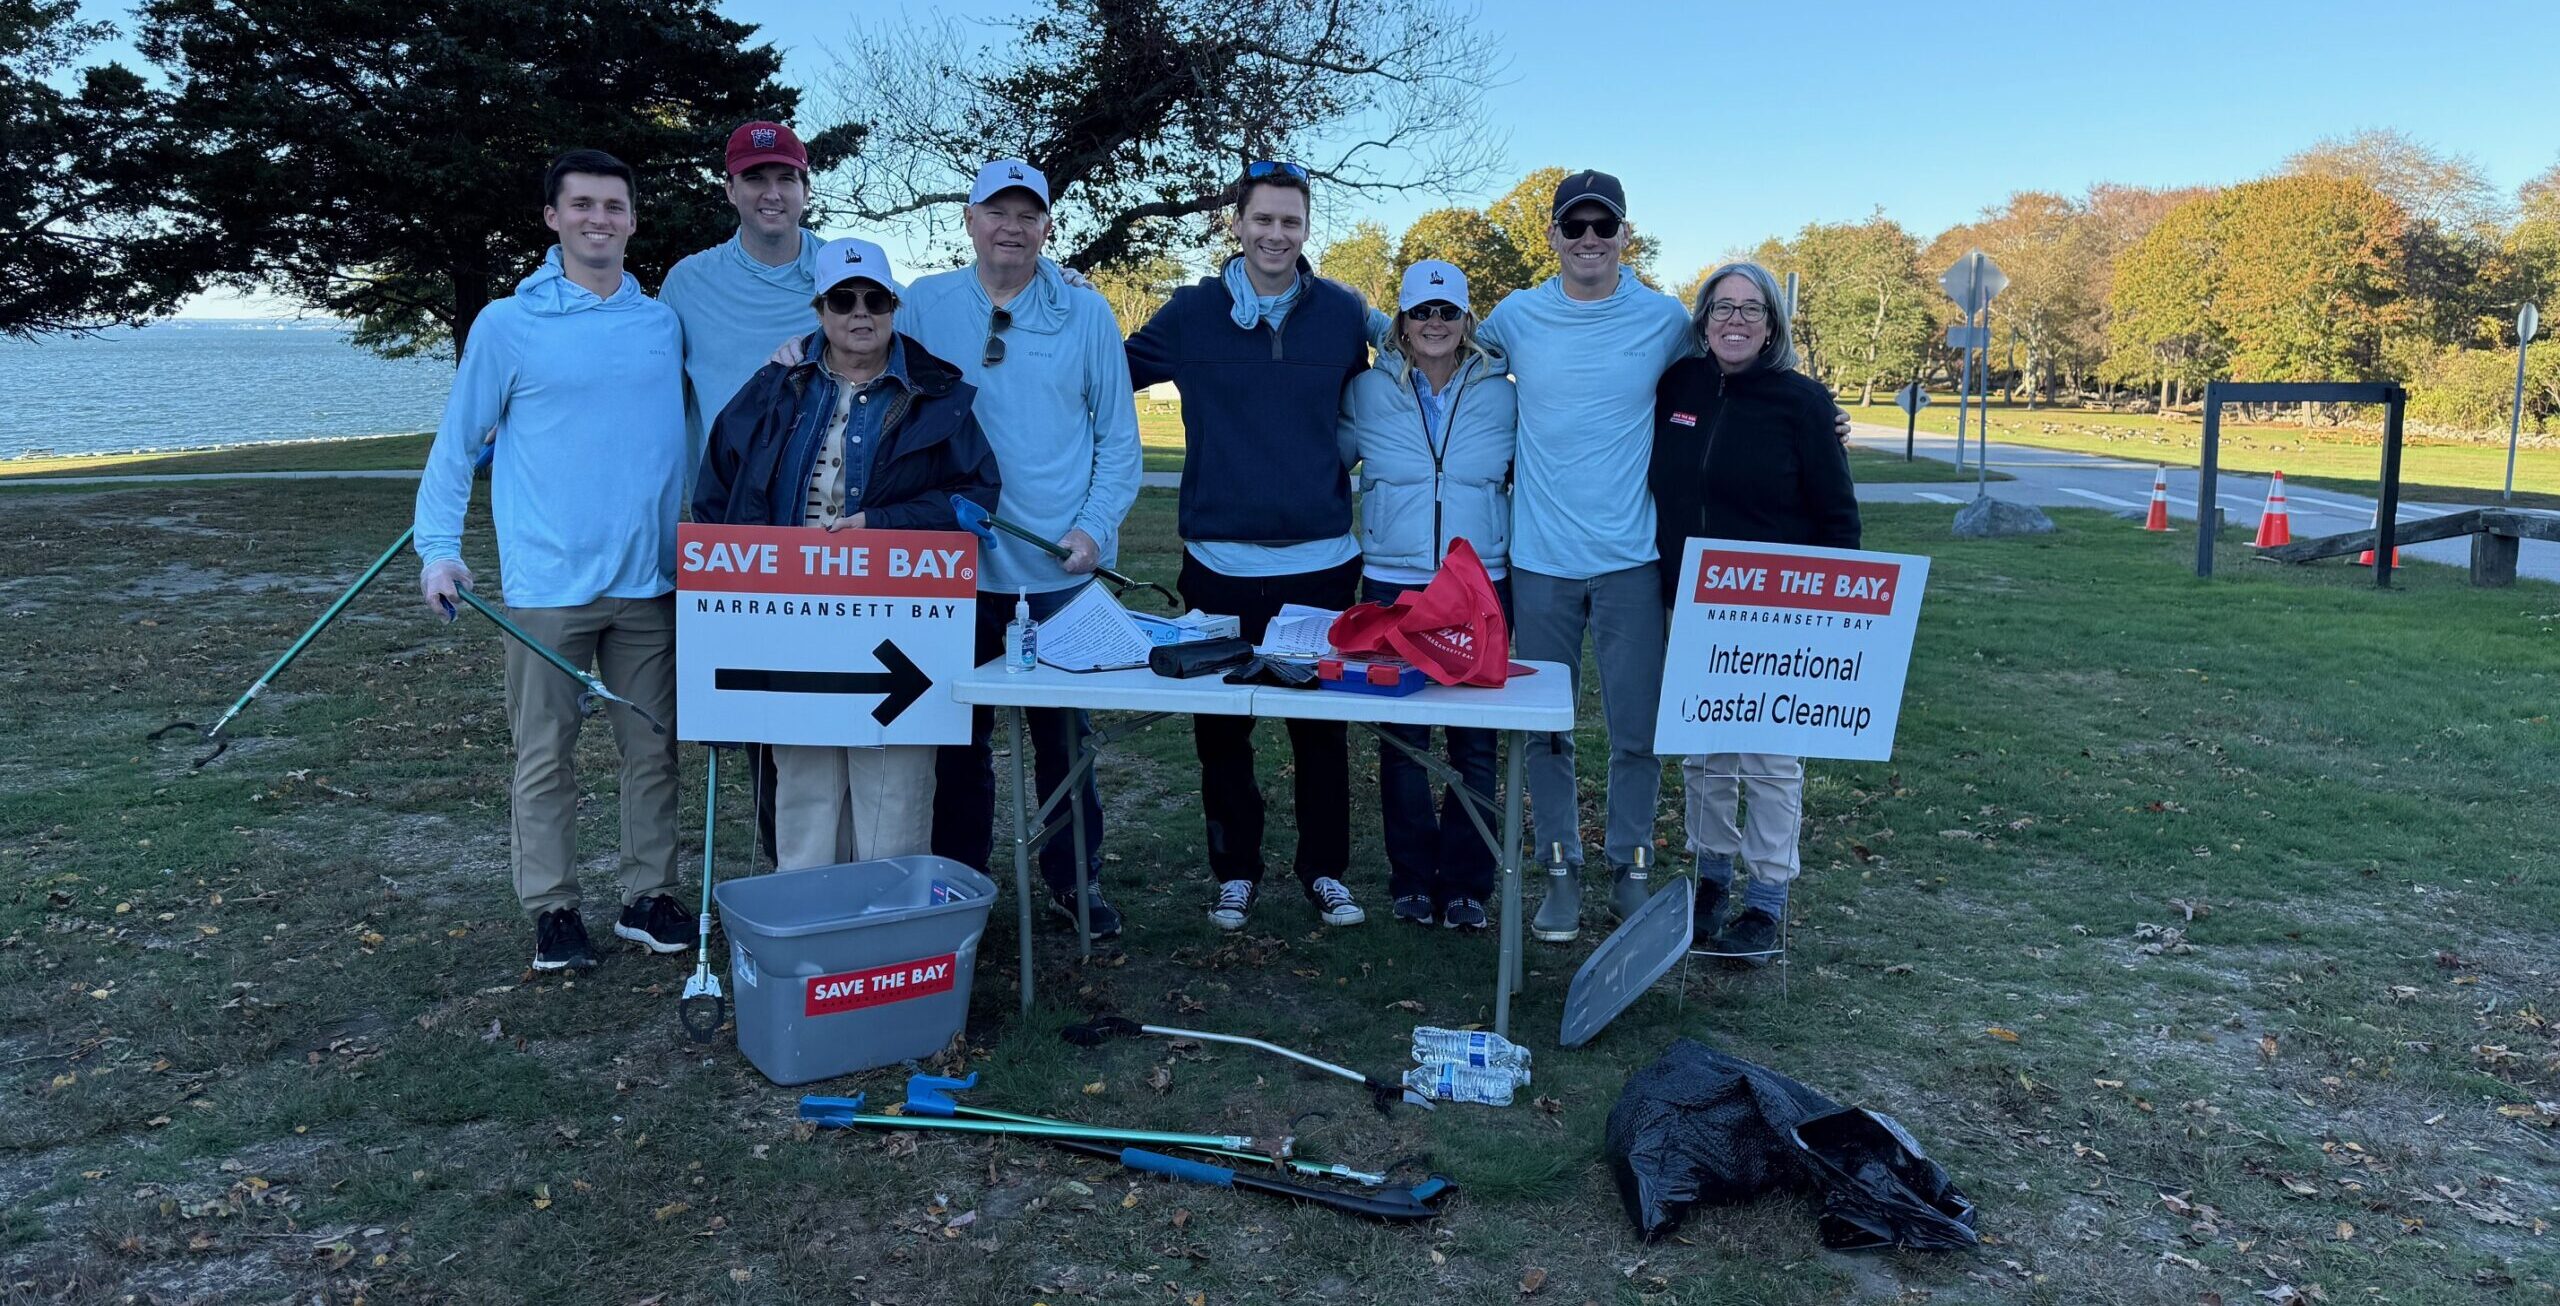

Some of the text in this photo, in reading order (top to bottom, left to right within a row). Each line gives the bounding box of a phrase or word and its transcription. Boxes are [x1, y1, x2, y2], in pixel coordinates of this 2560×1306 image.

[682, 541, 778, 574] SAVE
[800, 546, 869, 577] THE
[1704, 565, 1768, 592] SAVE
[1780, 570, 1826, 596] THE
[697, 599, 956, 619] NARRAGANSETT BAY
[1707, 609, 1873, 630] NARRAGANSETT BAY
[1708, 644, 1862, 681] International
[1771, 694, 1871, 736] Cleanup
[814, 978, 865, 1001] SAVE
[871, 971, 906, 992] THE
